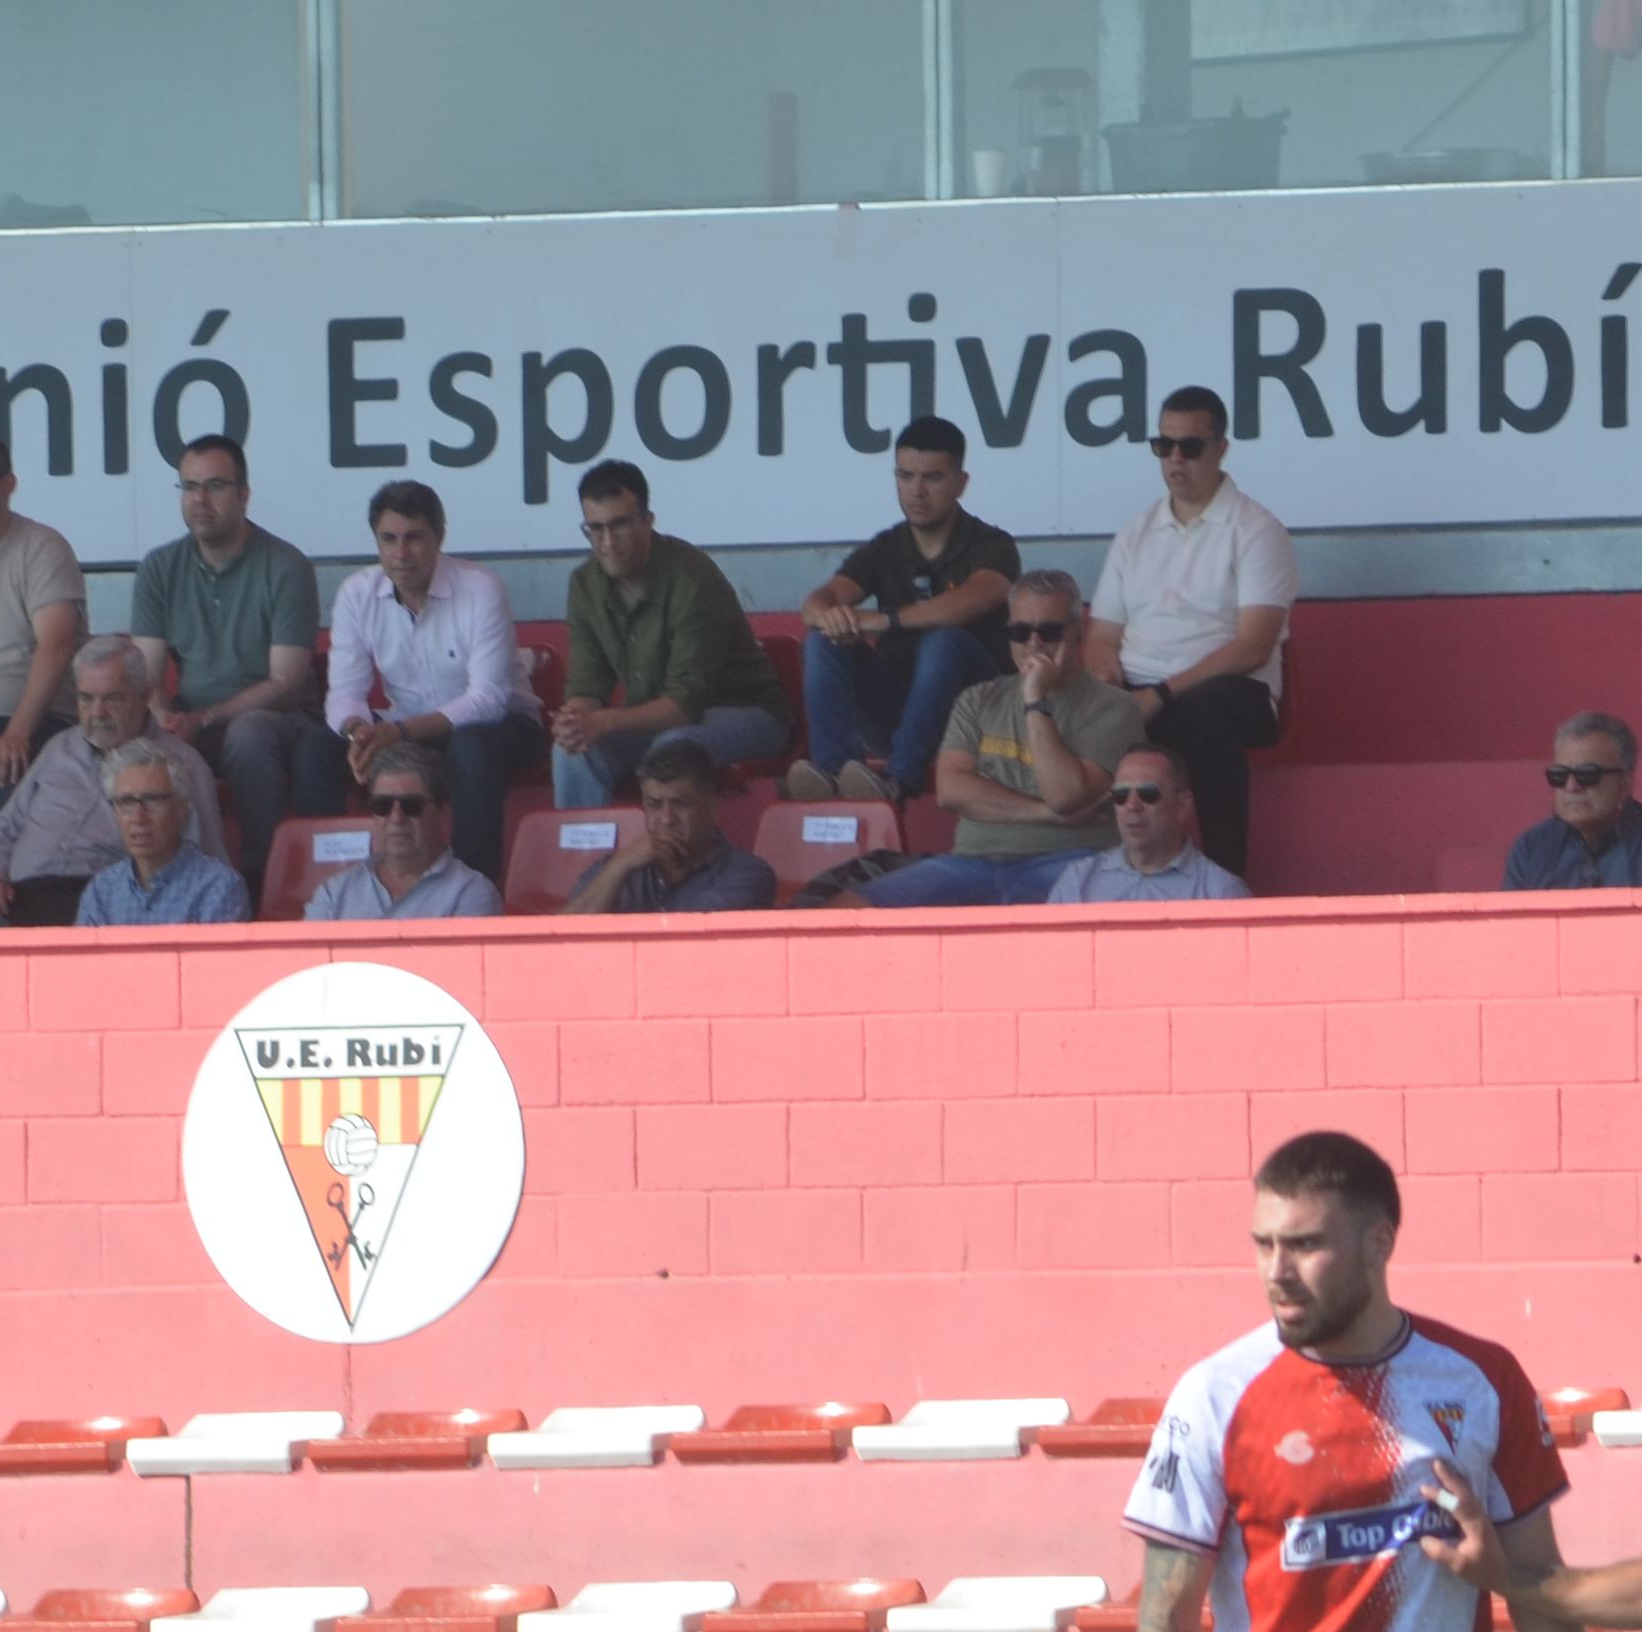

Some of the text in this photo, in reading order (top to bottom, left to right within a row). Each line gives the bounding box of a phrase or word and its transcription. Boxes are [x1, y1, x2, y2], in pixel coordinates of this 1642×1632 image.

[327, 292, 1149, 506] Esportiva
[256, 1038, 333, 1069] U.E.
[1336, 1520, 1386, 1550] Top
